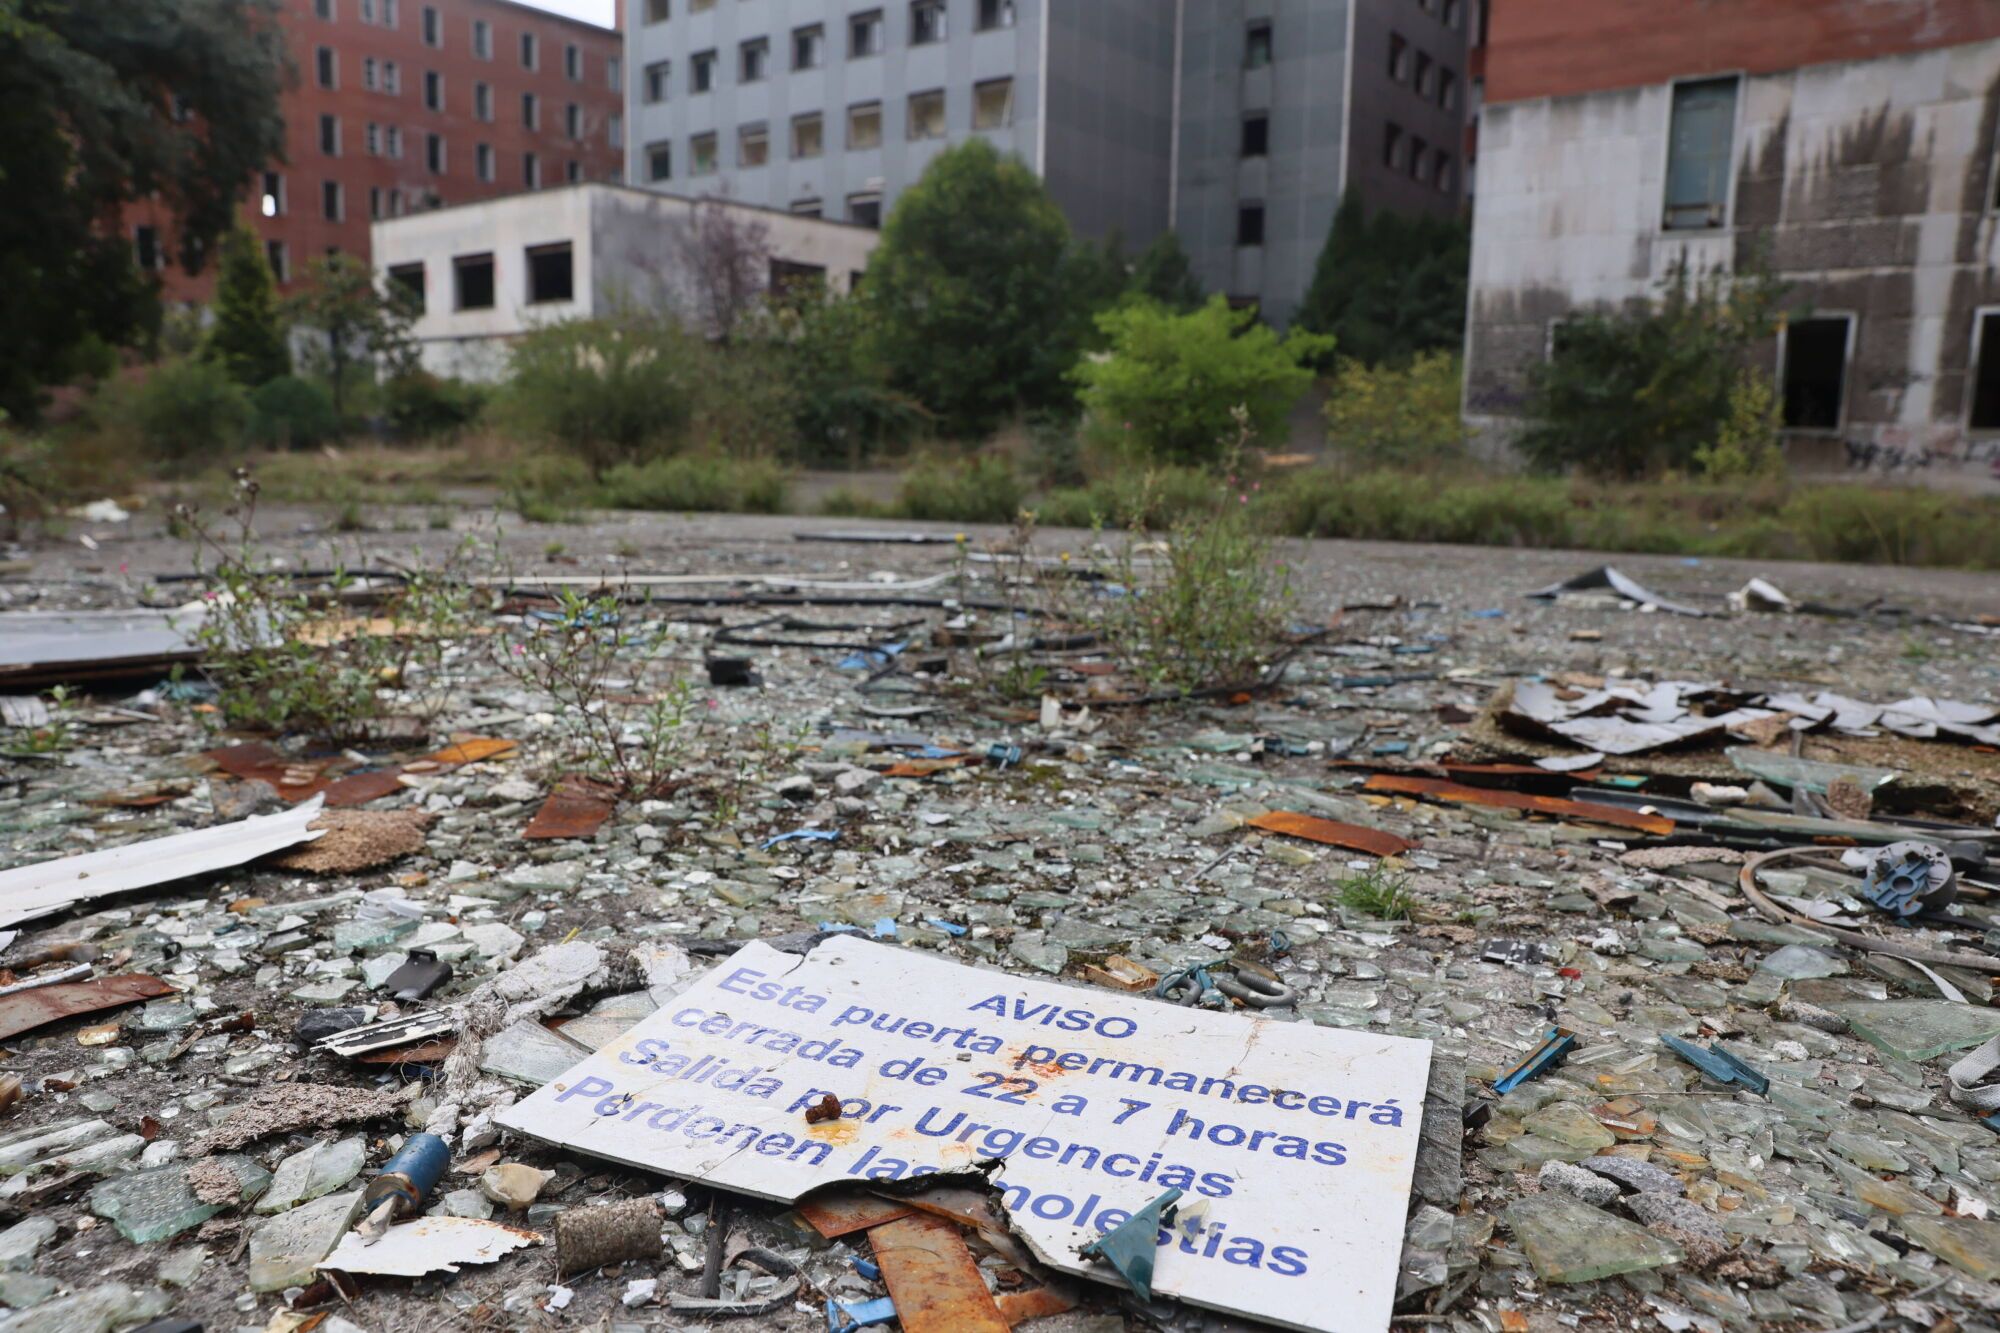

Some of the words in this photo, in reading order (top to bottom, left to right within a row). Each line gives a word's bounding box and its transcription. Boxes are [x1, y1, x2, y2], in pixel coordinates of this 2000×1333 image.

[671, 1007, 865, 1069] cerrada
[879, 1056, 948, 1086] de
[960, 1070, 1039, 1106] 22
[1051, 1093, 1089, 1117] a
[1112, 1097, 1152, 1125] 7
[1166, 1108, 1348, 1167] horas
[717, 967, 828, 1016] Esta
[830, 1004, 1005, 1055] puerta
[1013, 1042, 1404, 1128] permanecerá
[968, 993, 1138, 1039] AVISO
[554, 1075, 834, 1166] Perdonen
[992, 1180, 1309, 1277] oletias
[619, 1037, 784, 1098] Salida
[785, 1087, 903, 1124] por
[914, 1106, 1235, 1198] Urgencias
